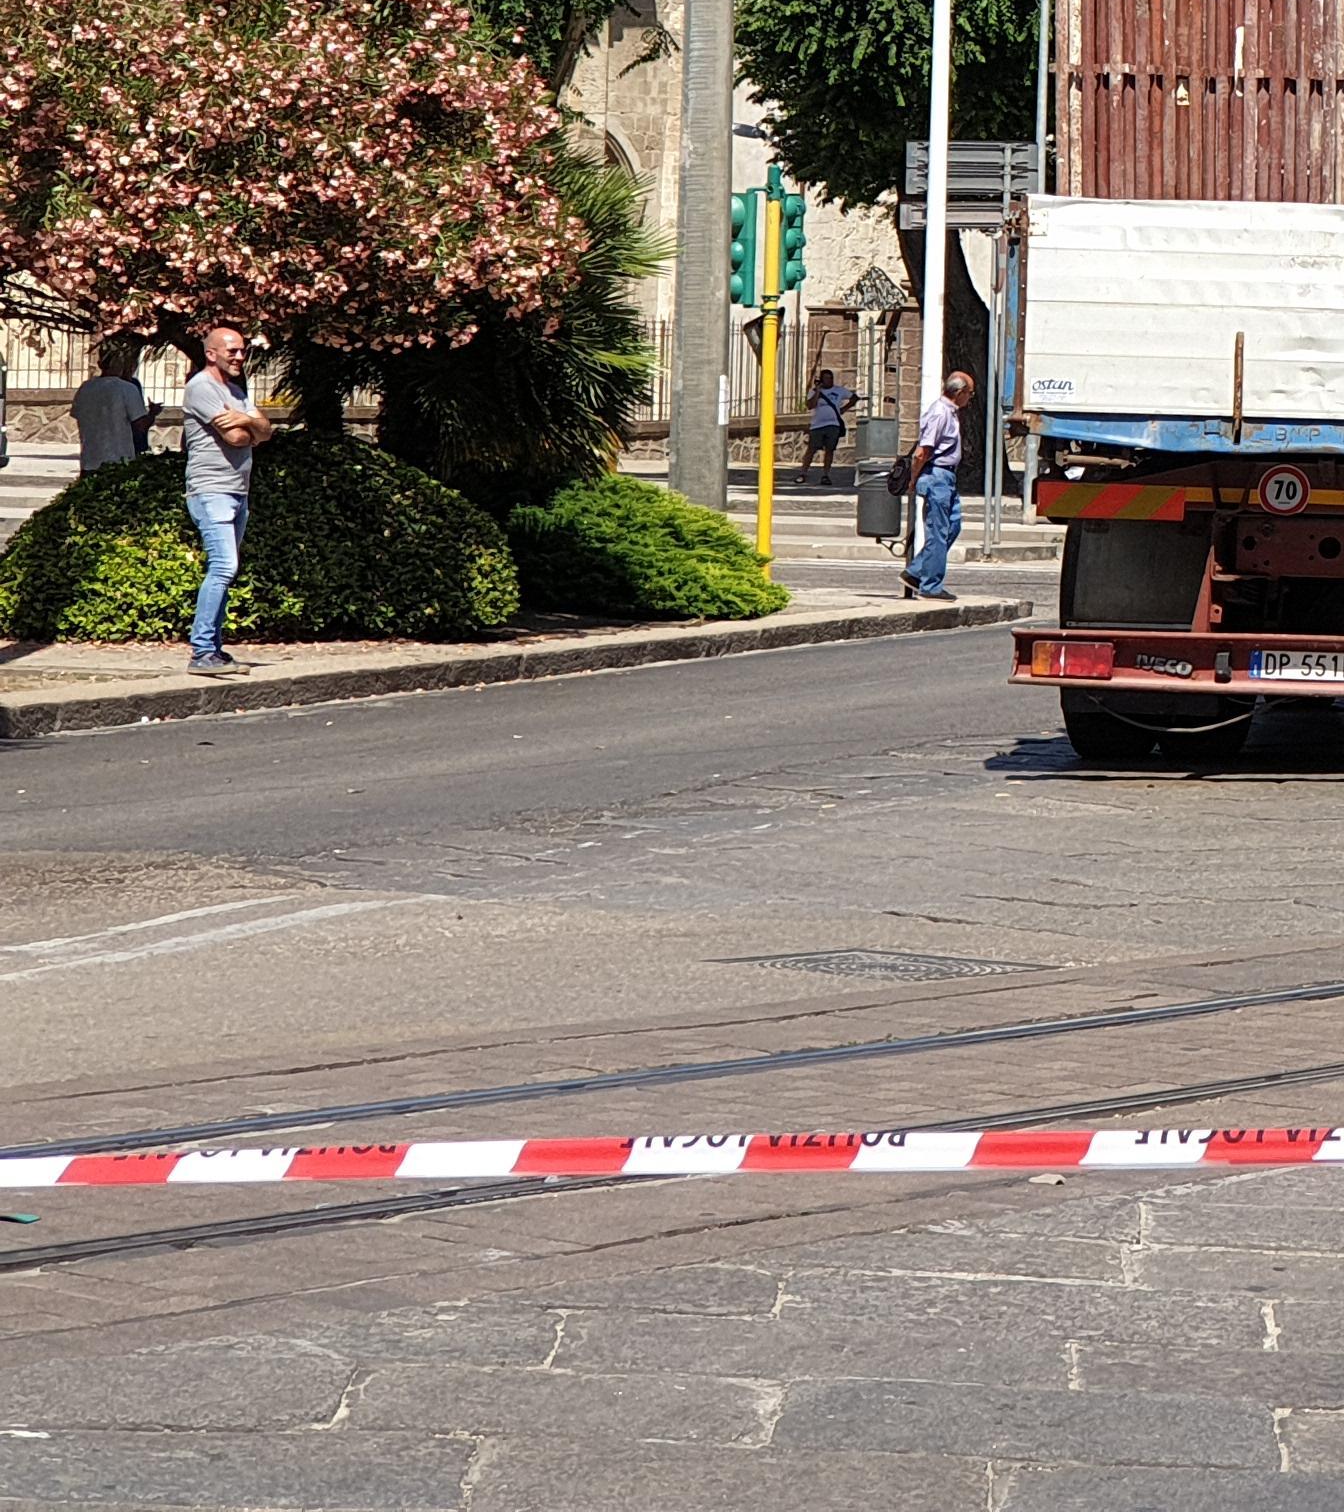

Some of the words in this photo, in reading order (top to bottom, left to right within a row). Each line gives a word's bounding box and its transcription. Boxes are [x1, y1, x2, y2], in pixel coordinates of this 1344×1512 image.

[1273, 479, 1298, 501] 70
[1135, 654, 1193, 676] IVECO
[1264, 652, 1291, 676] DP
